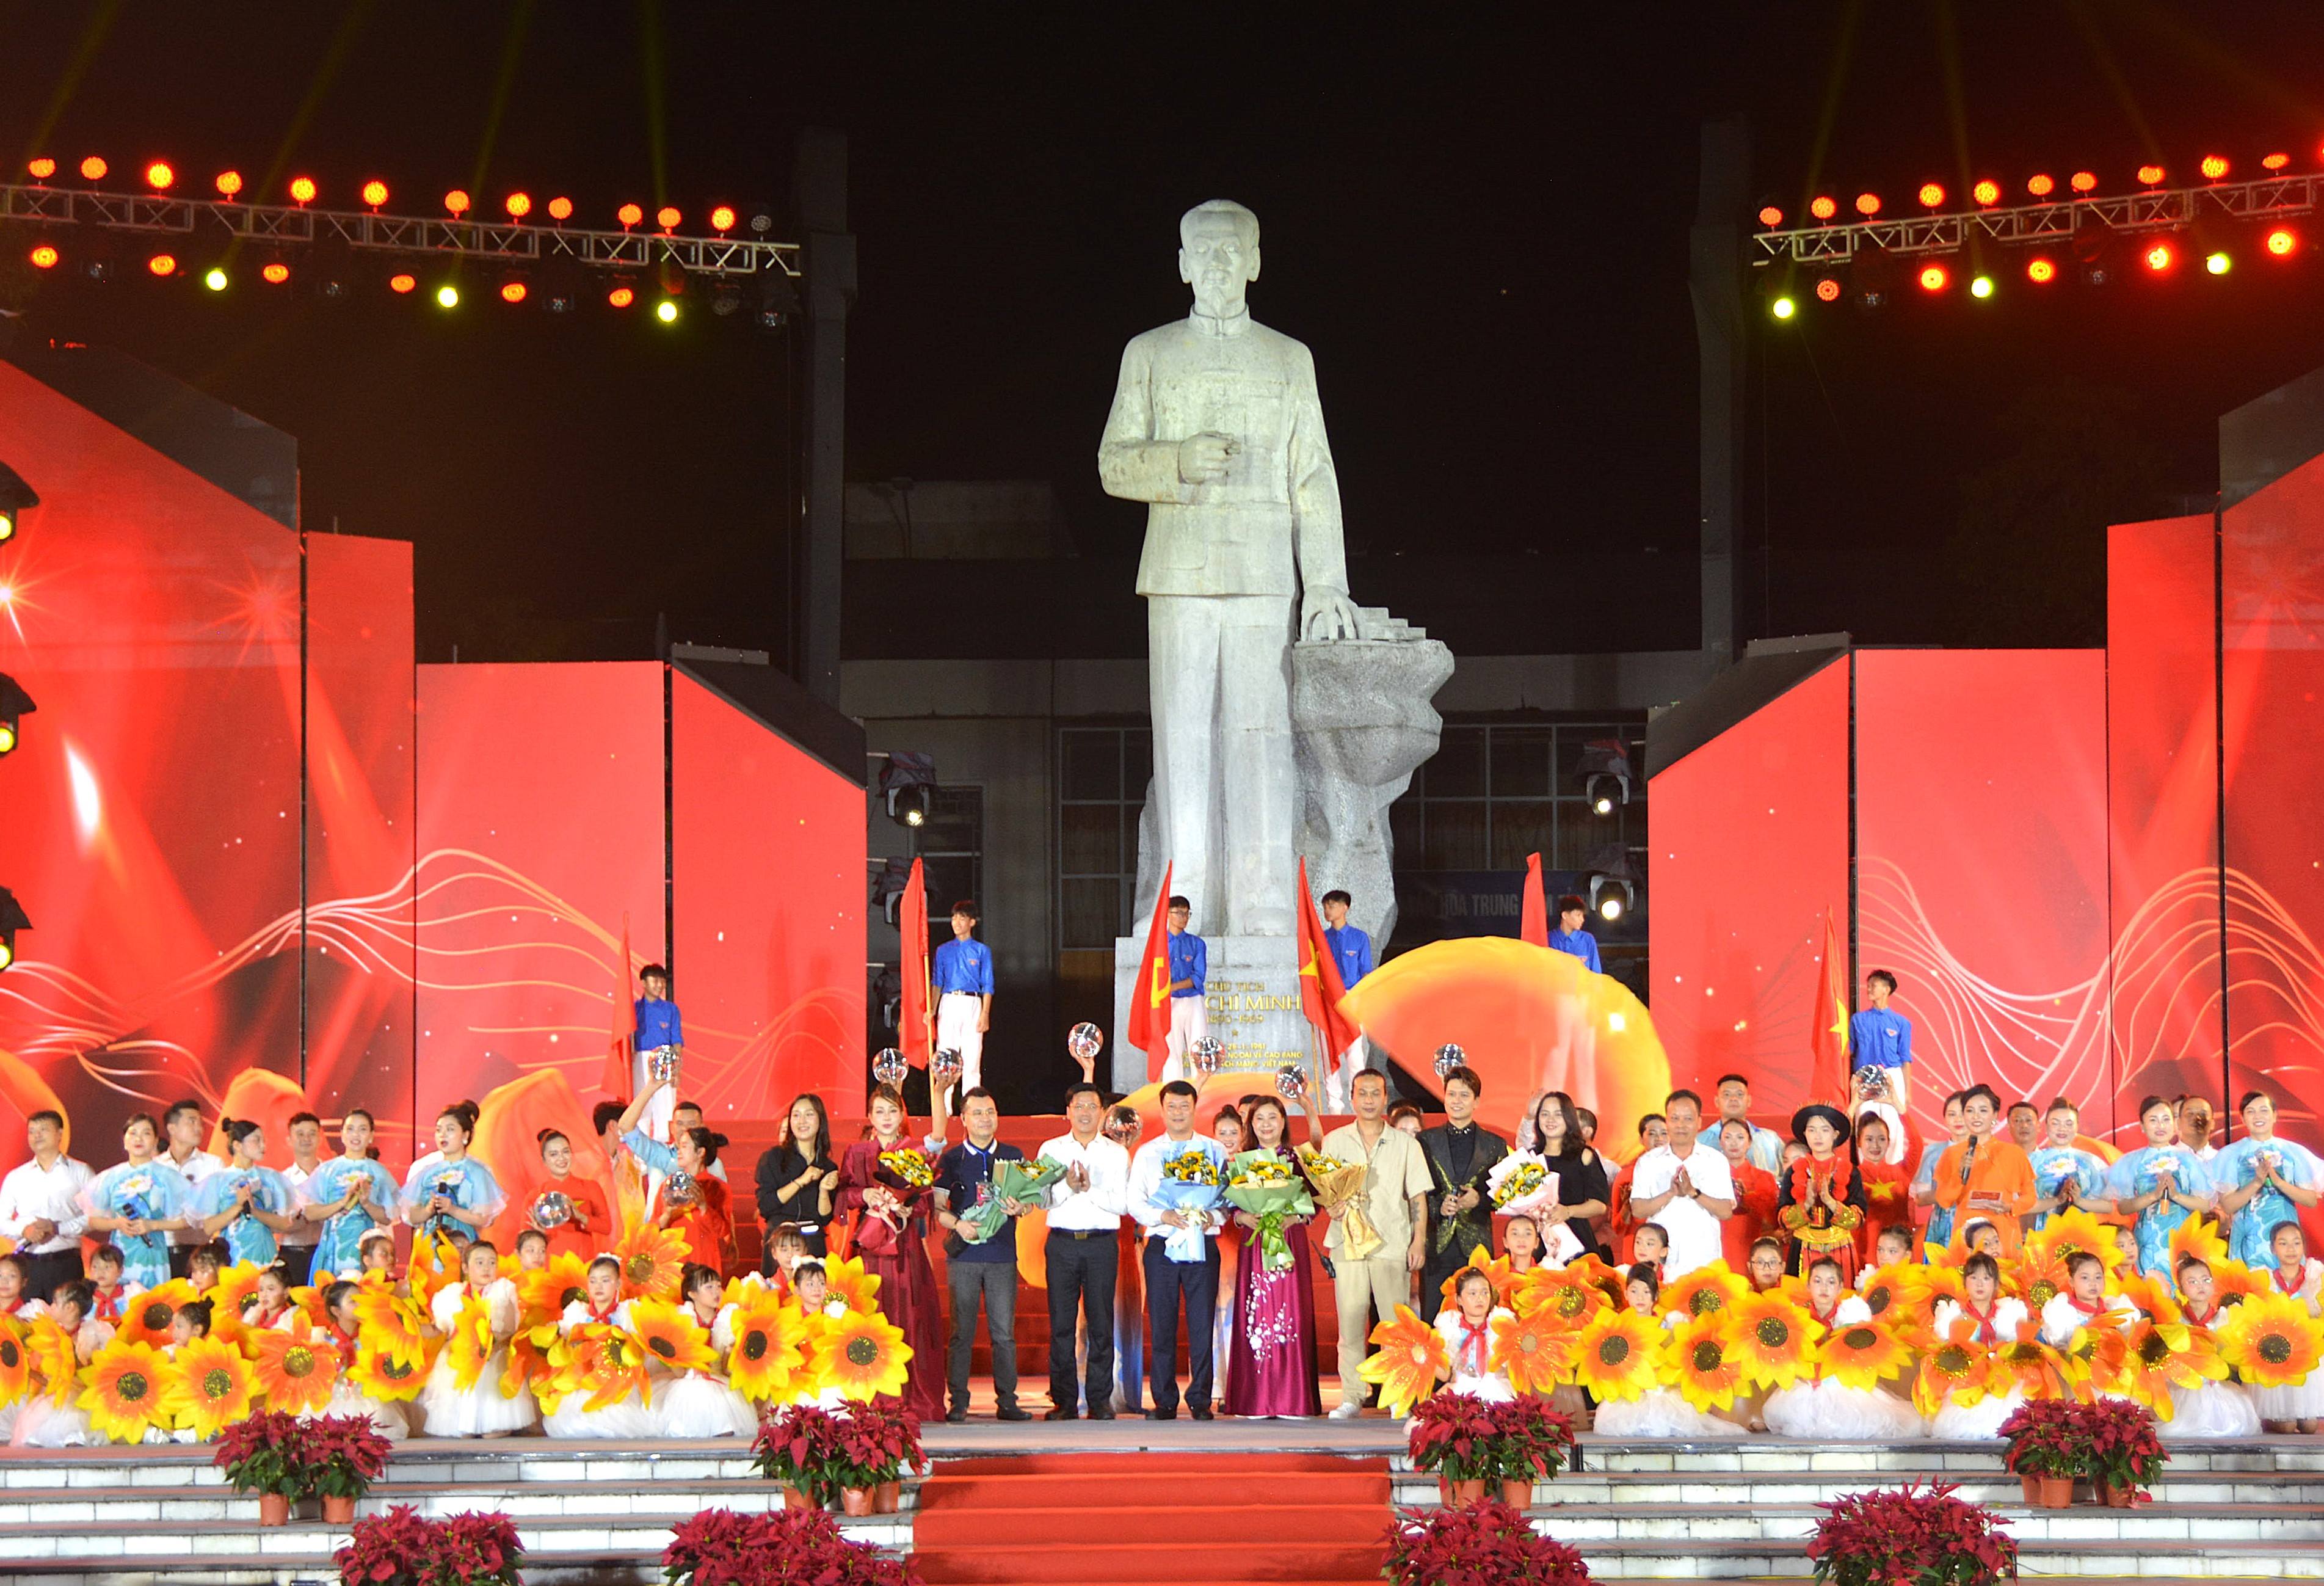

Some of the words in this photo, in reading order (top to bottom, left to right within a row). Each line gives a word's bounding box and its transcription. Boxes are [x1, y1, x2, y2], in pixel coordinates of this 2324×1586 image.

[1472, 893, 1519, 917] TRUNG
[1205, 994, 1239, 1011] CHÍ
[1245, 995, 1301, 1011] MINH
